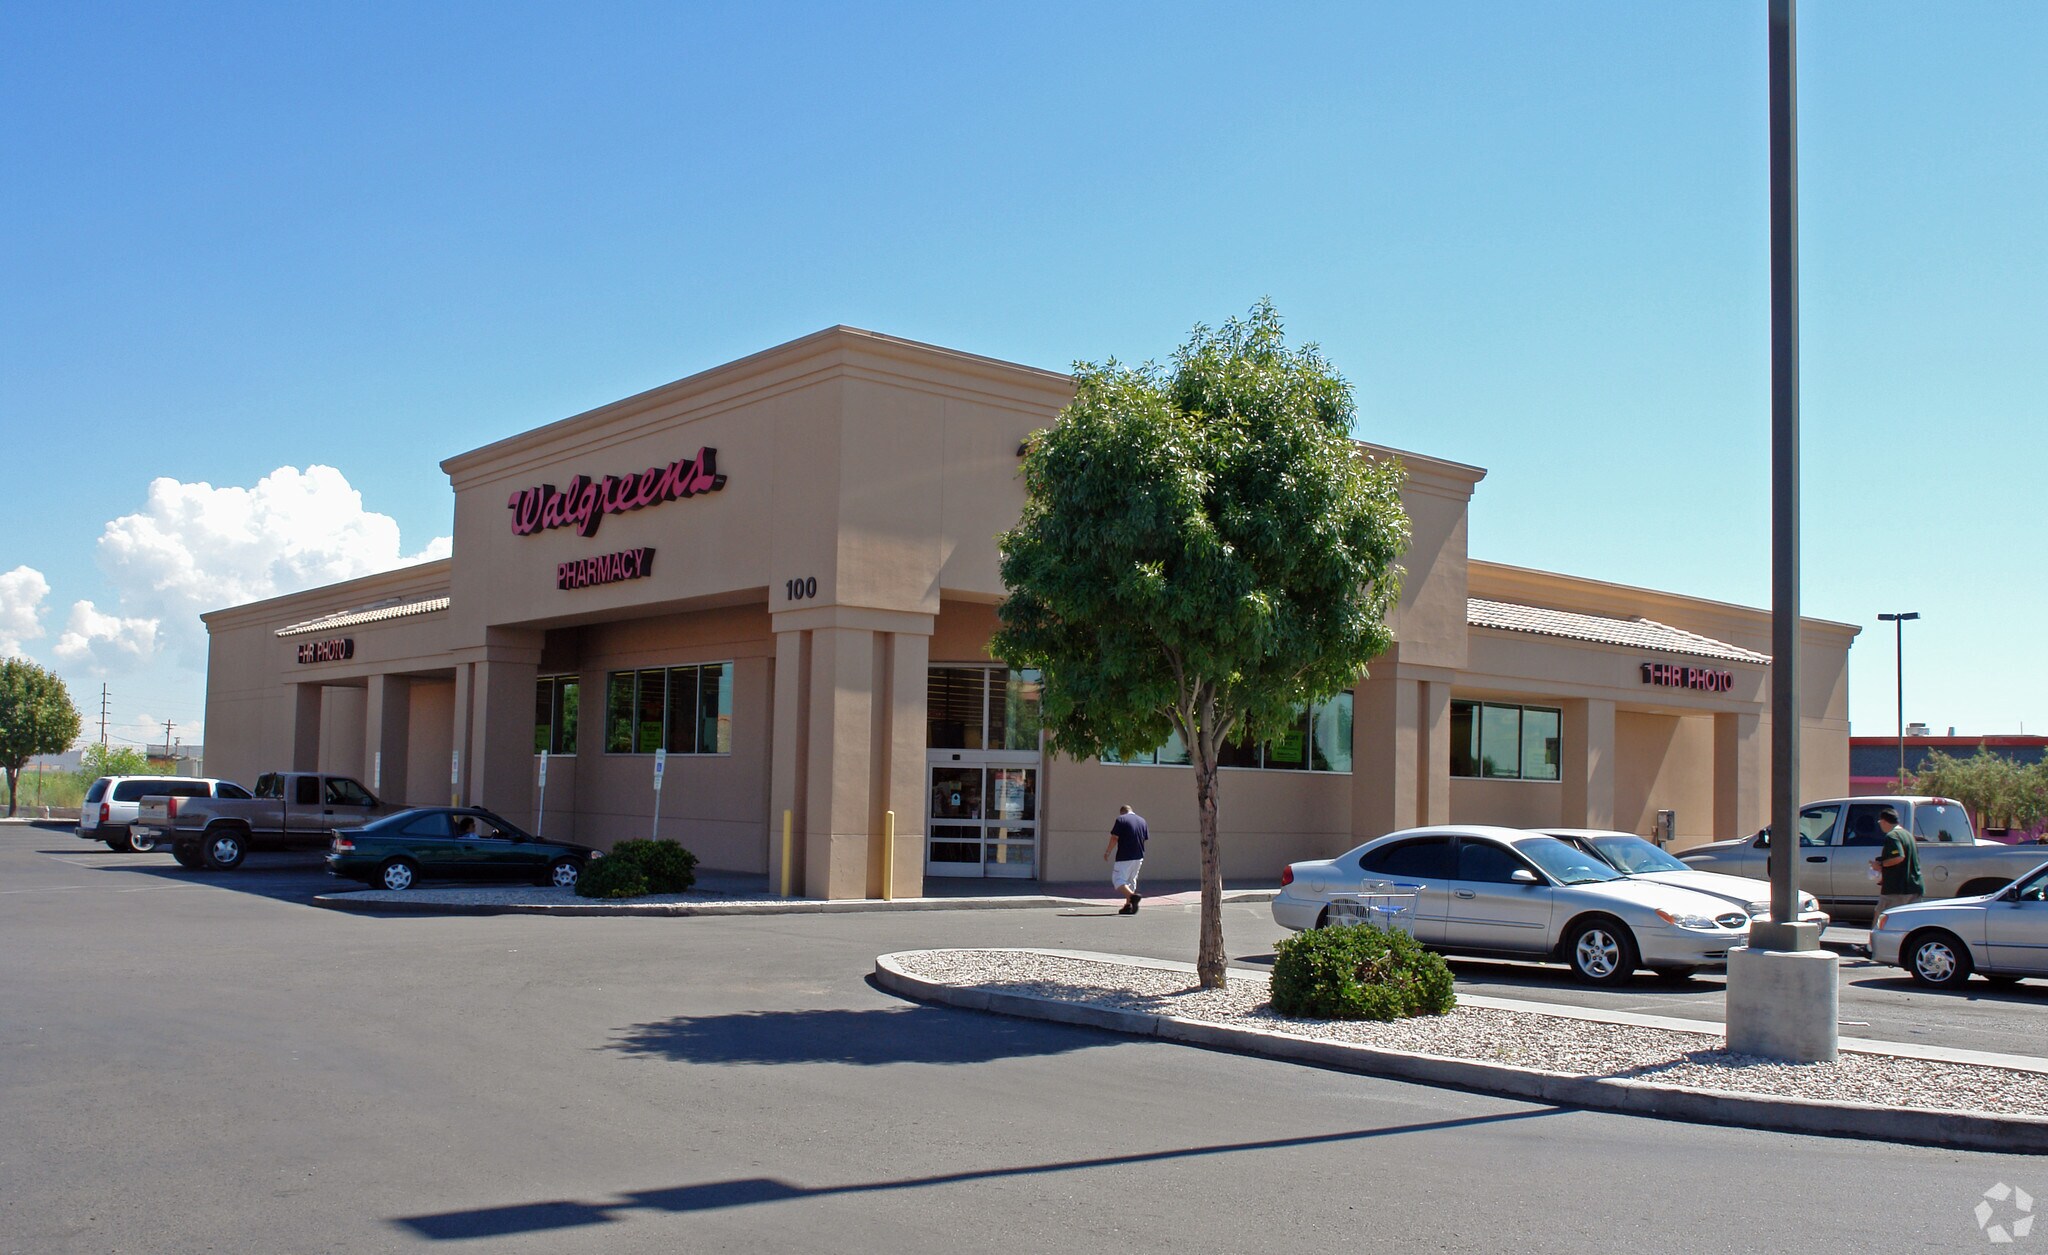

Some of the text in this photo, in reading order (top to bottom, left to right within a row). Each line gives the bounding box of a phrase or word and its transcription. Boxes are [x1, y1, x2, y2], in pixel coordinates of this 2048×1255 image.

[508, 447, 719, 536] Walgreens
[557, 548, 650, 589] PHARMACY
[786, 577, 817, 600] 100
[317, 639, 348, 661] PHOTO
[1643, 663, 1734, 691] 1-HR PHOTO
